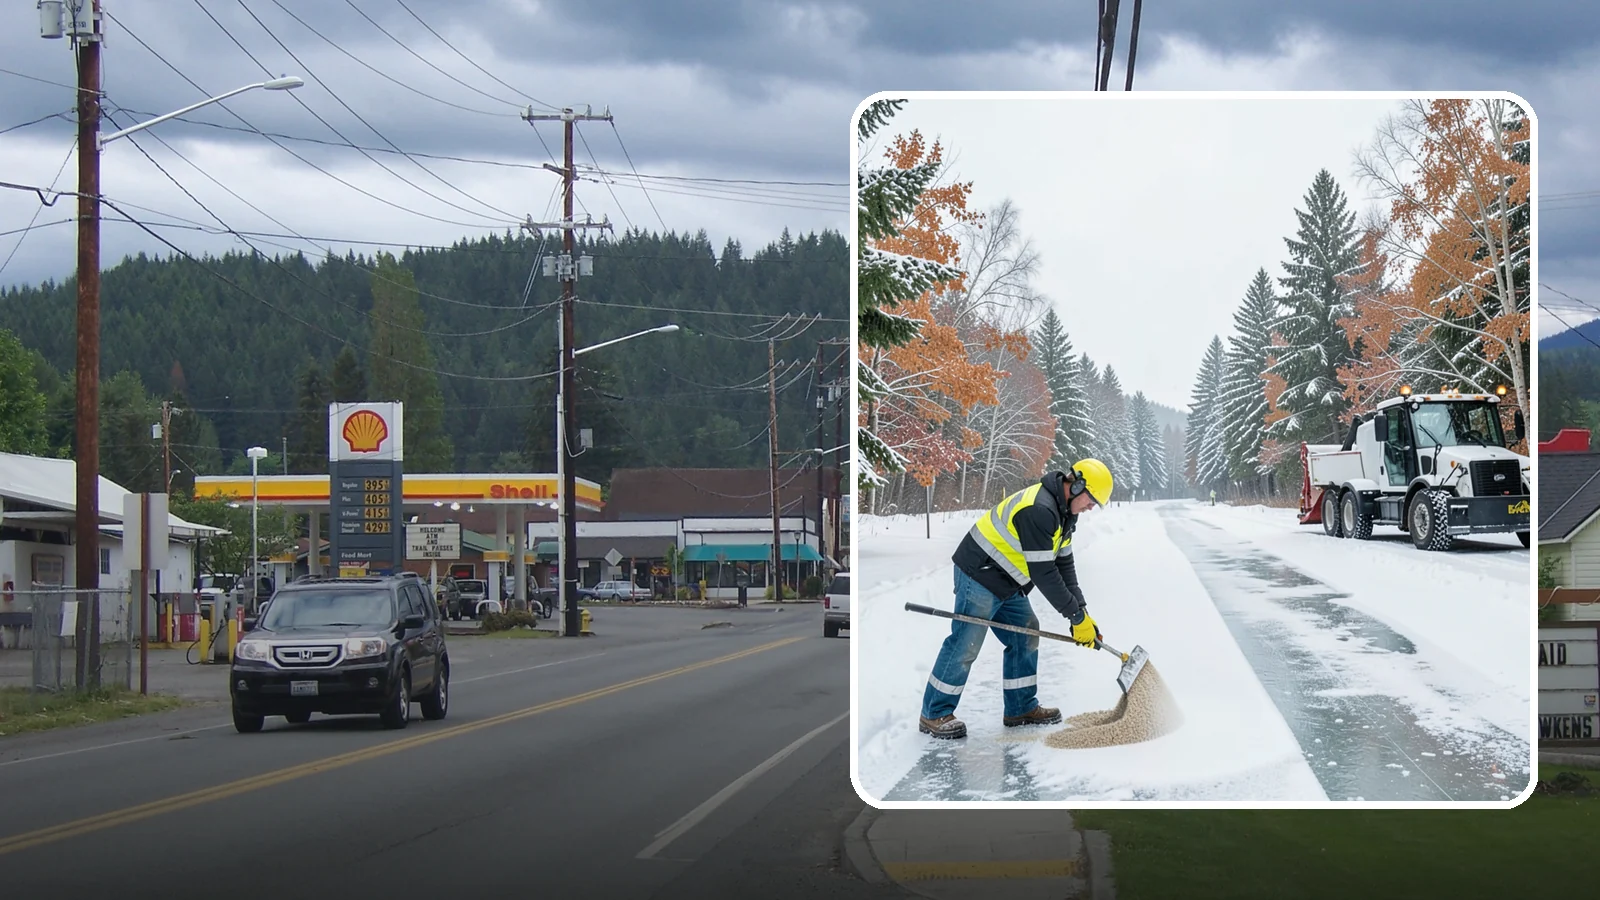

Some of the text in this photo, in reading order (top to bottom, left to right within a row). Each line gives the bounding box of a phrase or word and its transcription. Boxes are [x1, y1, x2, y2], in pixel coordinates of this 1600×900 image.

[365, 480, 383, 490] 395
[490, 484, 547, 499] Shell
[365, 494, 383, 504] 405
[365, 508, 383, 518] 415
[366, 522, 383, 533] 429
